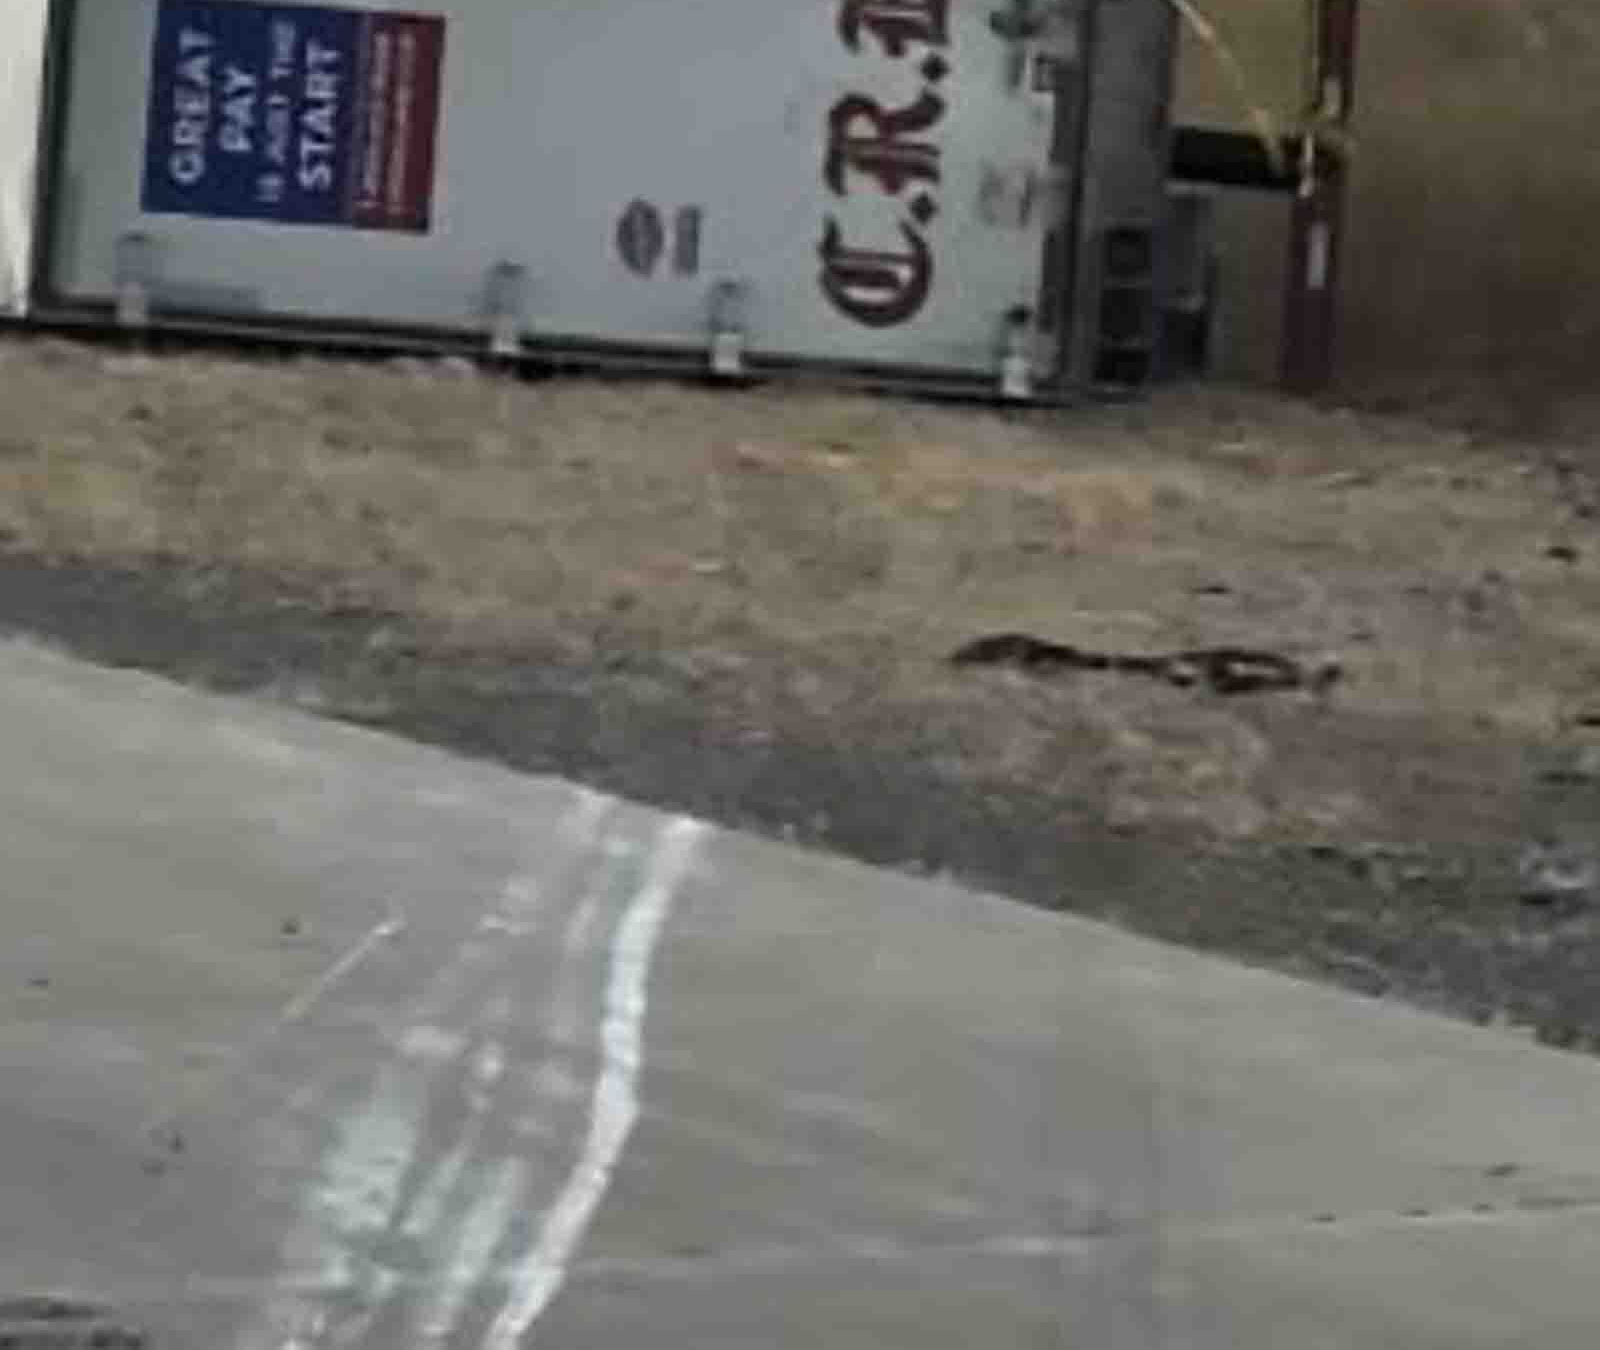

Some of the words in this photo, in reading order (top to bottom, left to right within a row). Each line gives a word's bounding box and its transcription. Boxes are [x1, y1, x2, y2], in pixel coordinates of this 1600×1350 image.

[168, 26, 217, 185] GREAT
[218, 64, 259, 153] PAY
[297, 40, 343, 193] START
